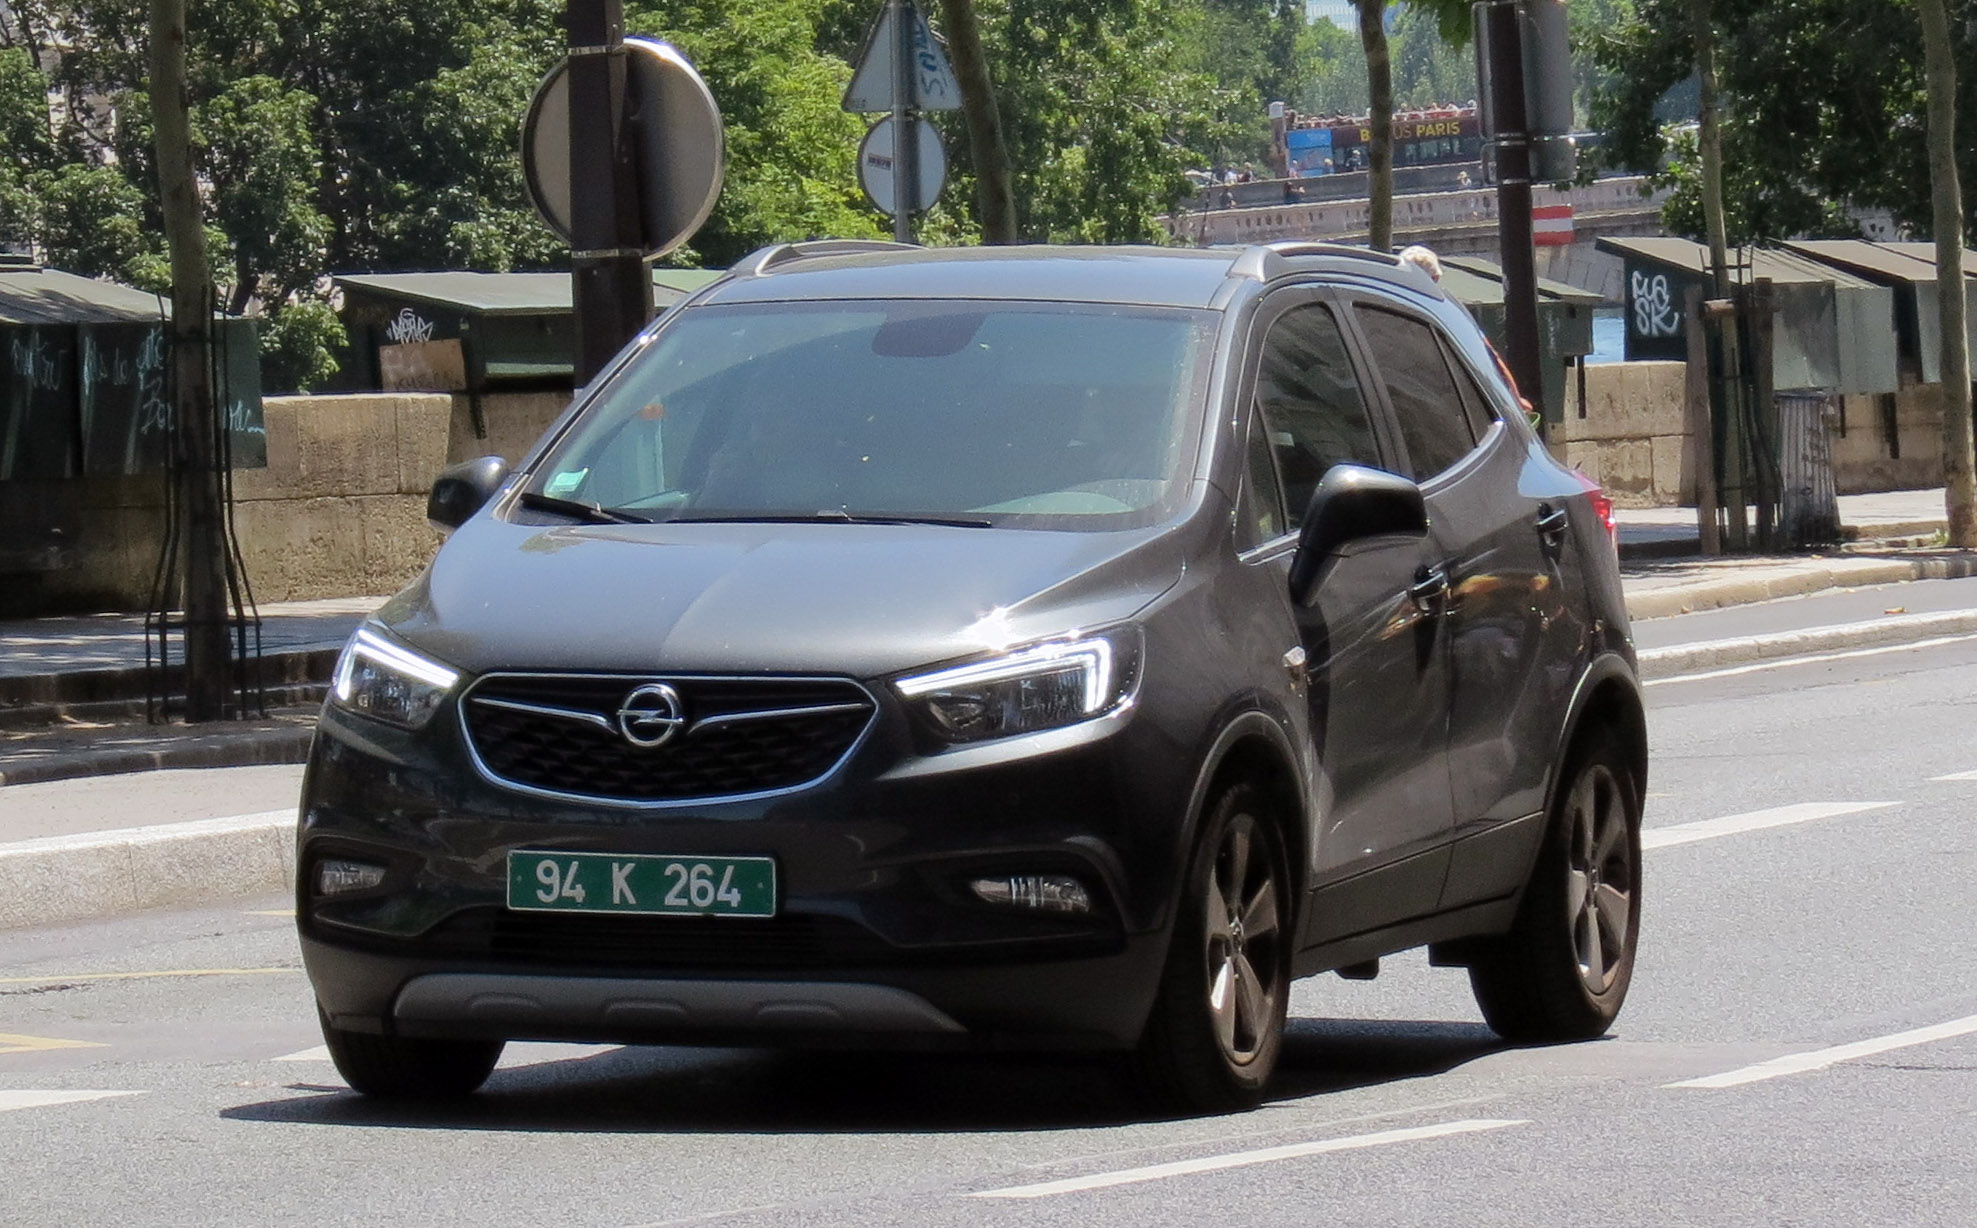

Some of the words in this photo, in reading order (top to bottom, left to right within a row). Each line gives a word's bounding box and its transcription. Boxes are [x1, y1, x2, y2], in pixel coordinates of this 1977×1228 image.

[1416, 121, 1460, 137] PARIS
[536, 859, 586, 904] 94
[612, 862, 636, 905] K
[664, 863, 741, 907] 264
